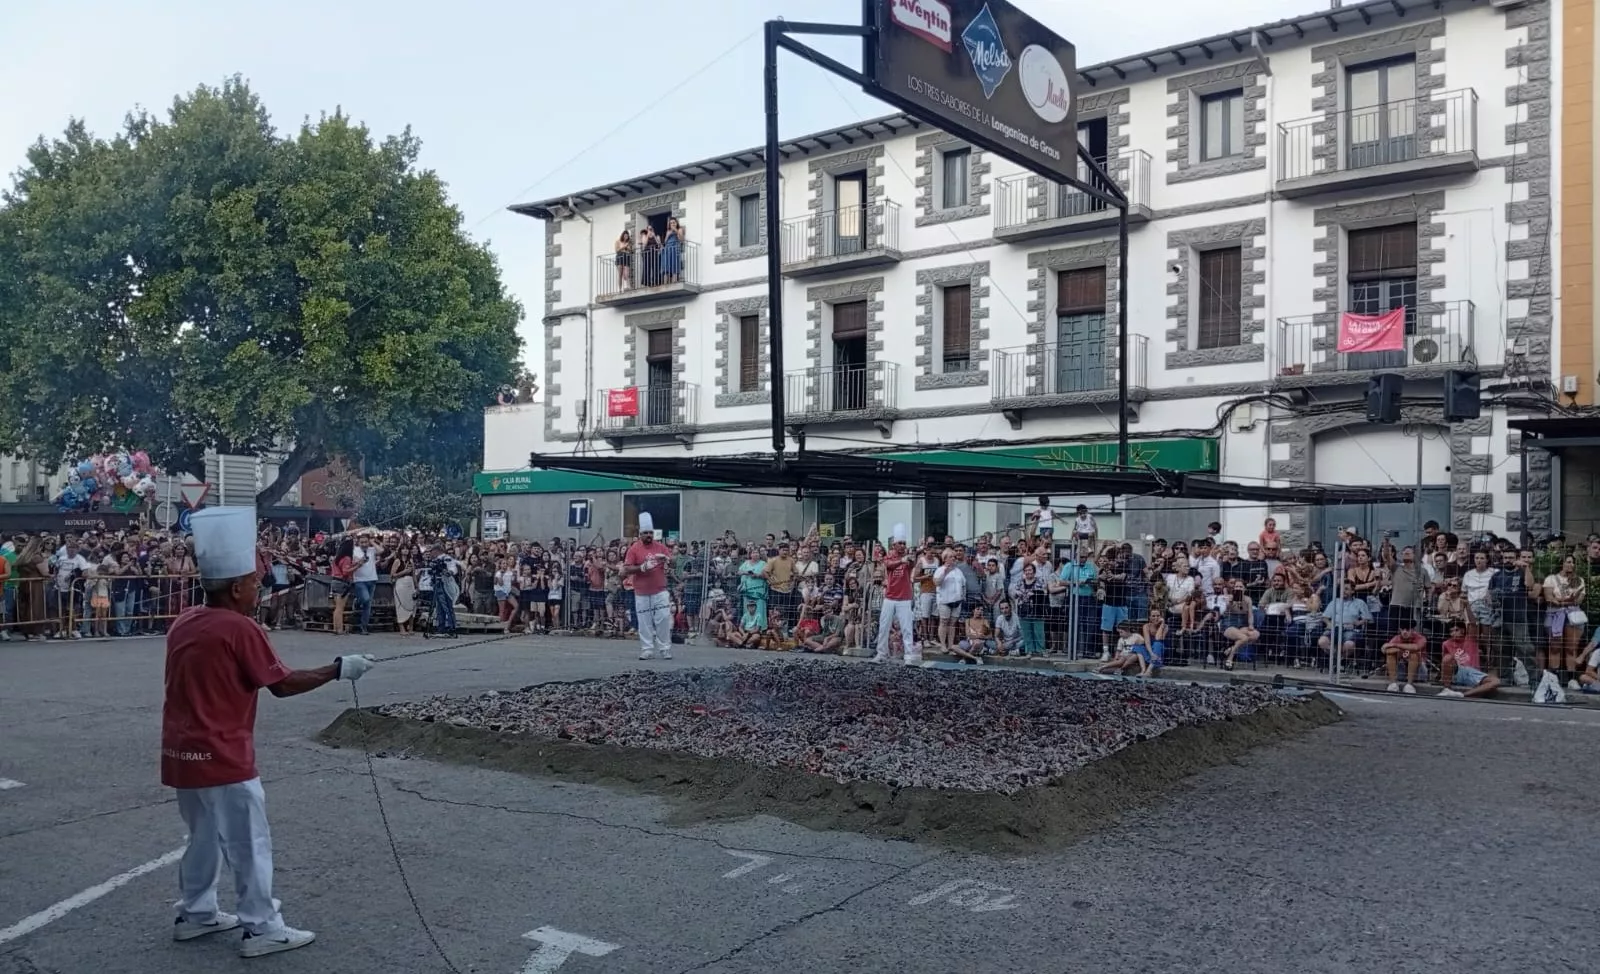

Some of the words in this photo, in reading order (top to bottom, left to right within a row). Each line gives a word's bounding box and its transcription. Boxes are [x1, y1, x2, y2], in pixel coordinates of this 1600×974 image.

[971, 40, 1009, 71] Melsa
[907, 74, 923, 93] LOS
[924, 82, 940, 101] TRES
[940, 91, 971, 117] SABORES
[972, 106, 981, 122] DE
[982, 111, 990, 126] LA
[991, 115, 1029, 145] Longaniza
[1029, 135, 1039, 150] de
[1040, 140, 1060, 160] Graus
[181, 752, 212, 760] GRAUS
